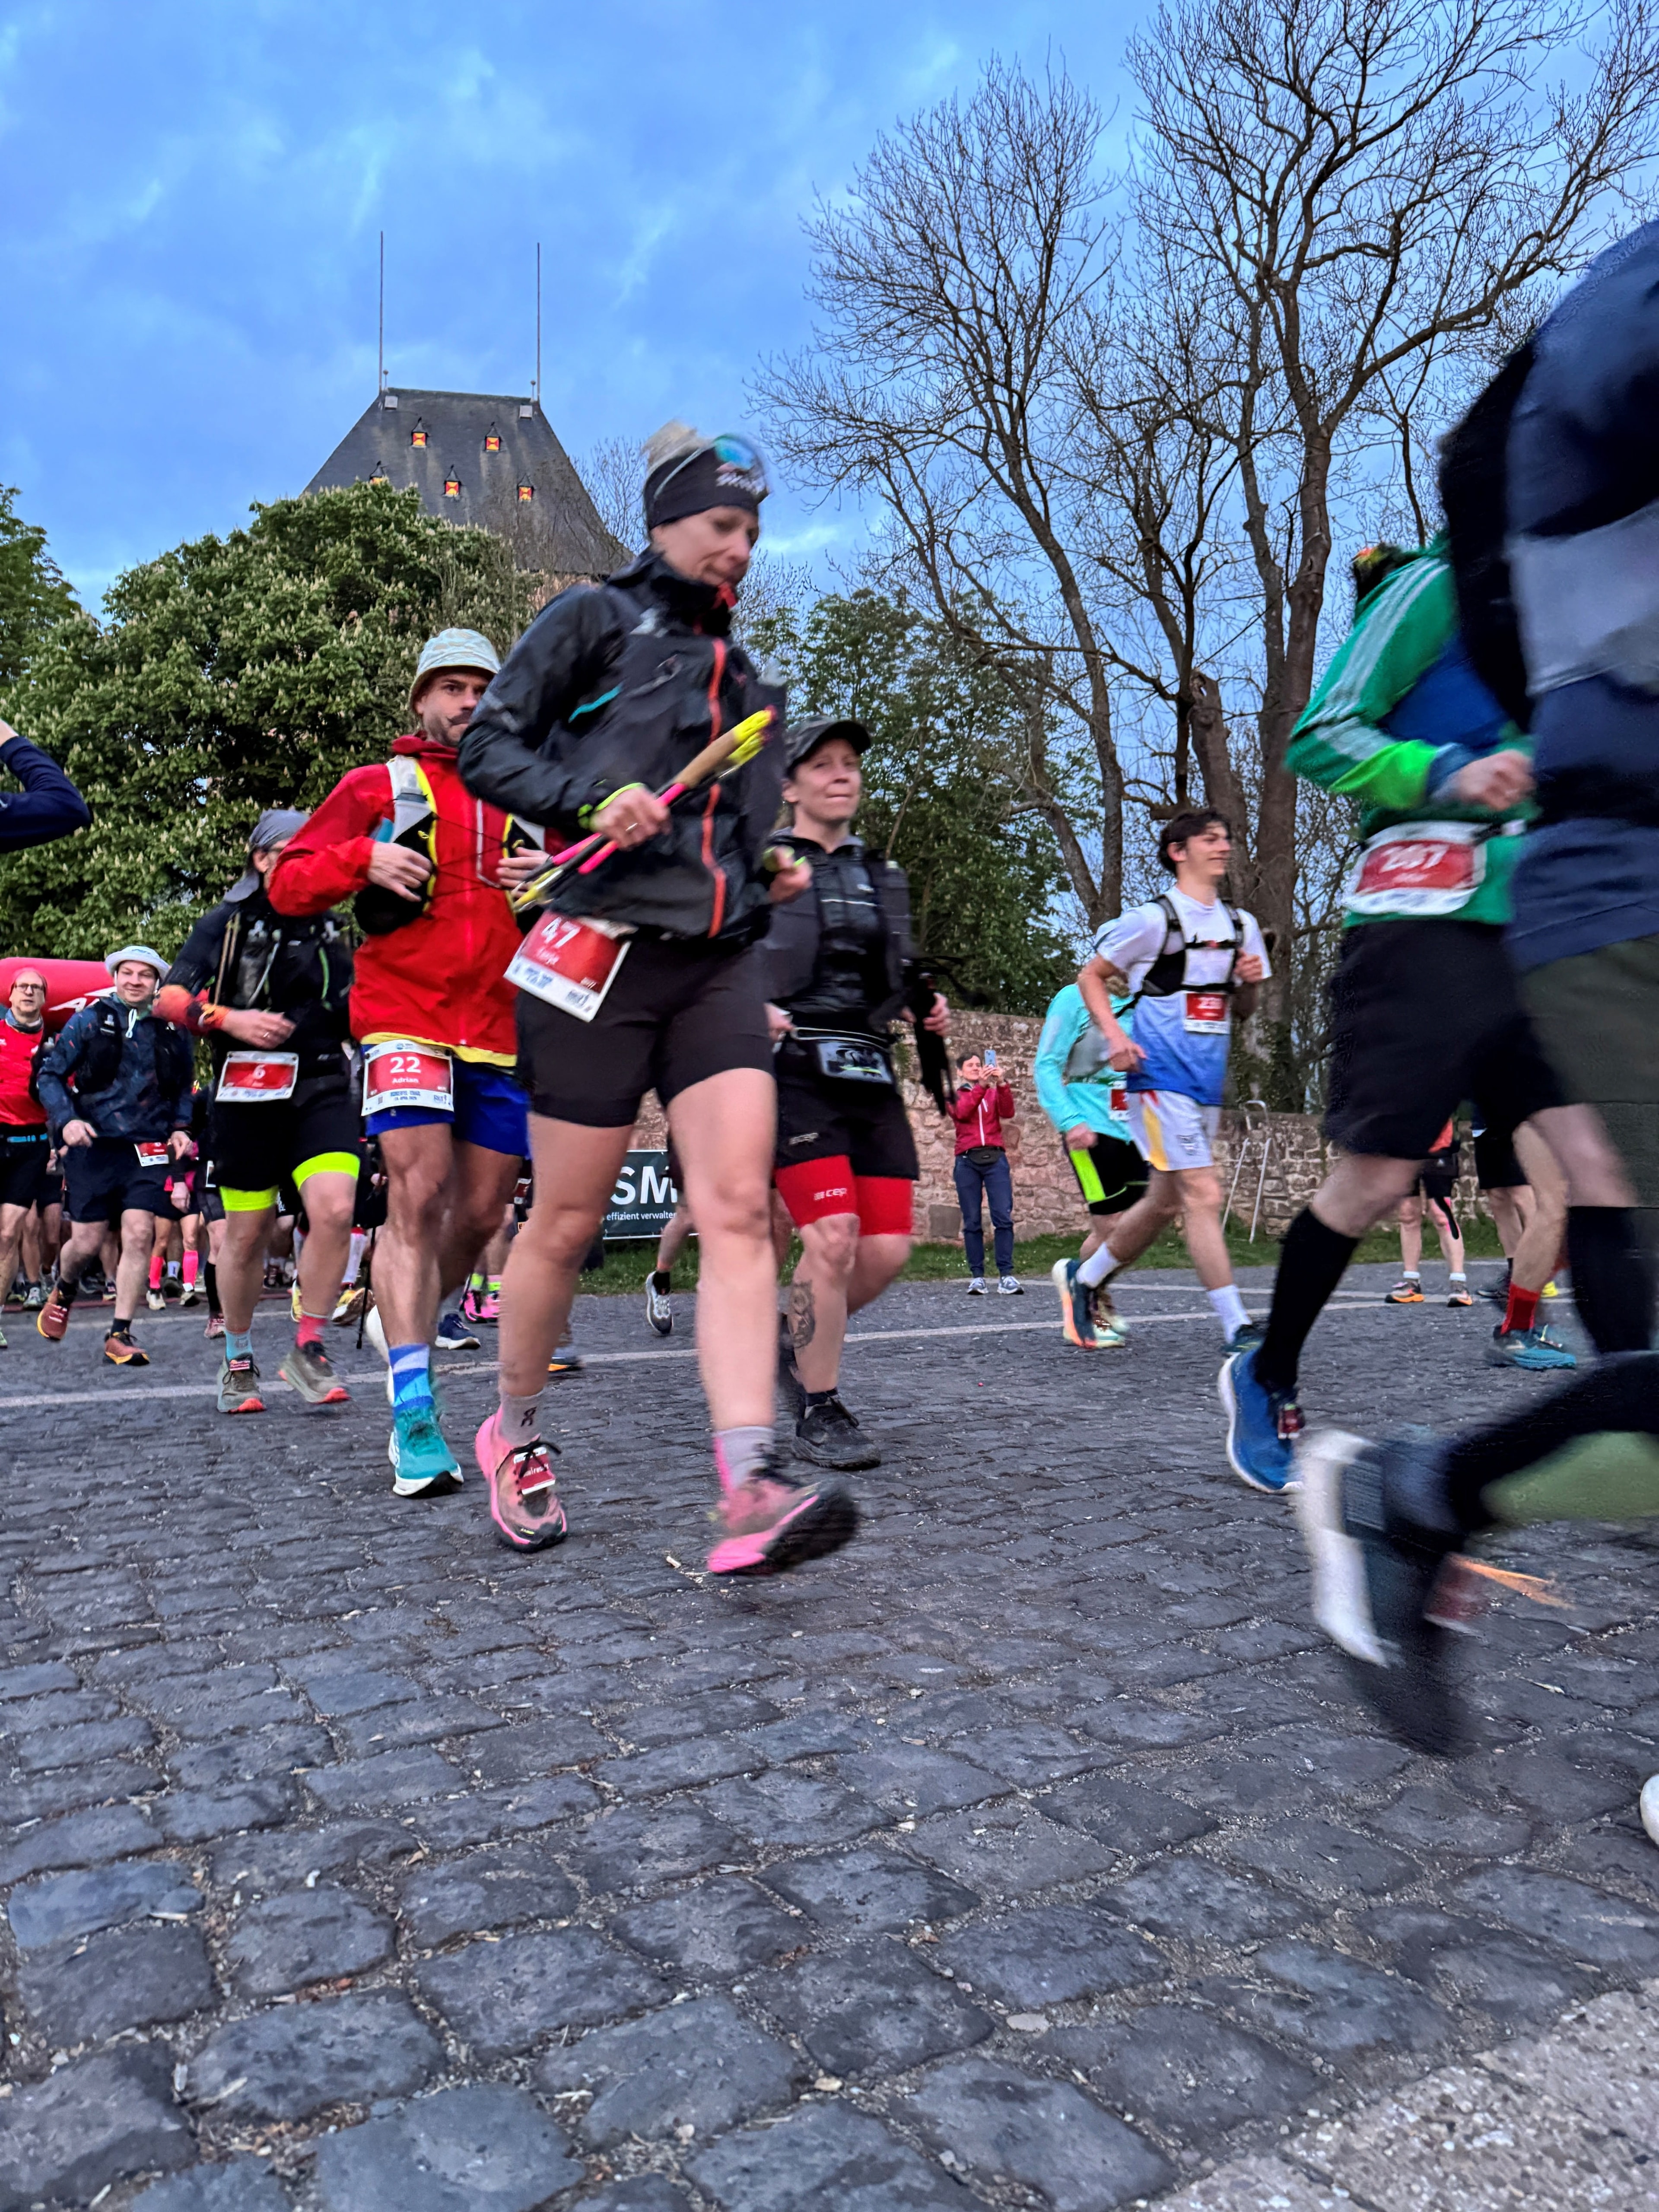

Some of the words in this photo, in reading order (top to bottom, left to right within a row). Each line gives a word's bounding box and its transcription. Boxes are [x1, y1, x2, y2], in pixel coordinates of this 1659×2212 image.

[541, 917, 582, 949] 47
[253, 1064, 266, 1079] 6
[390, 1056, 421, 1074] 22
[826, 1188, 847, 1197] cep
[606, 1211, 639, 1221] effizient
